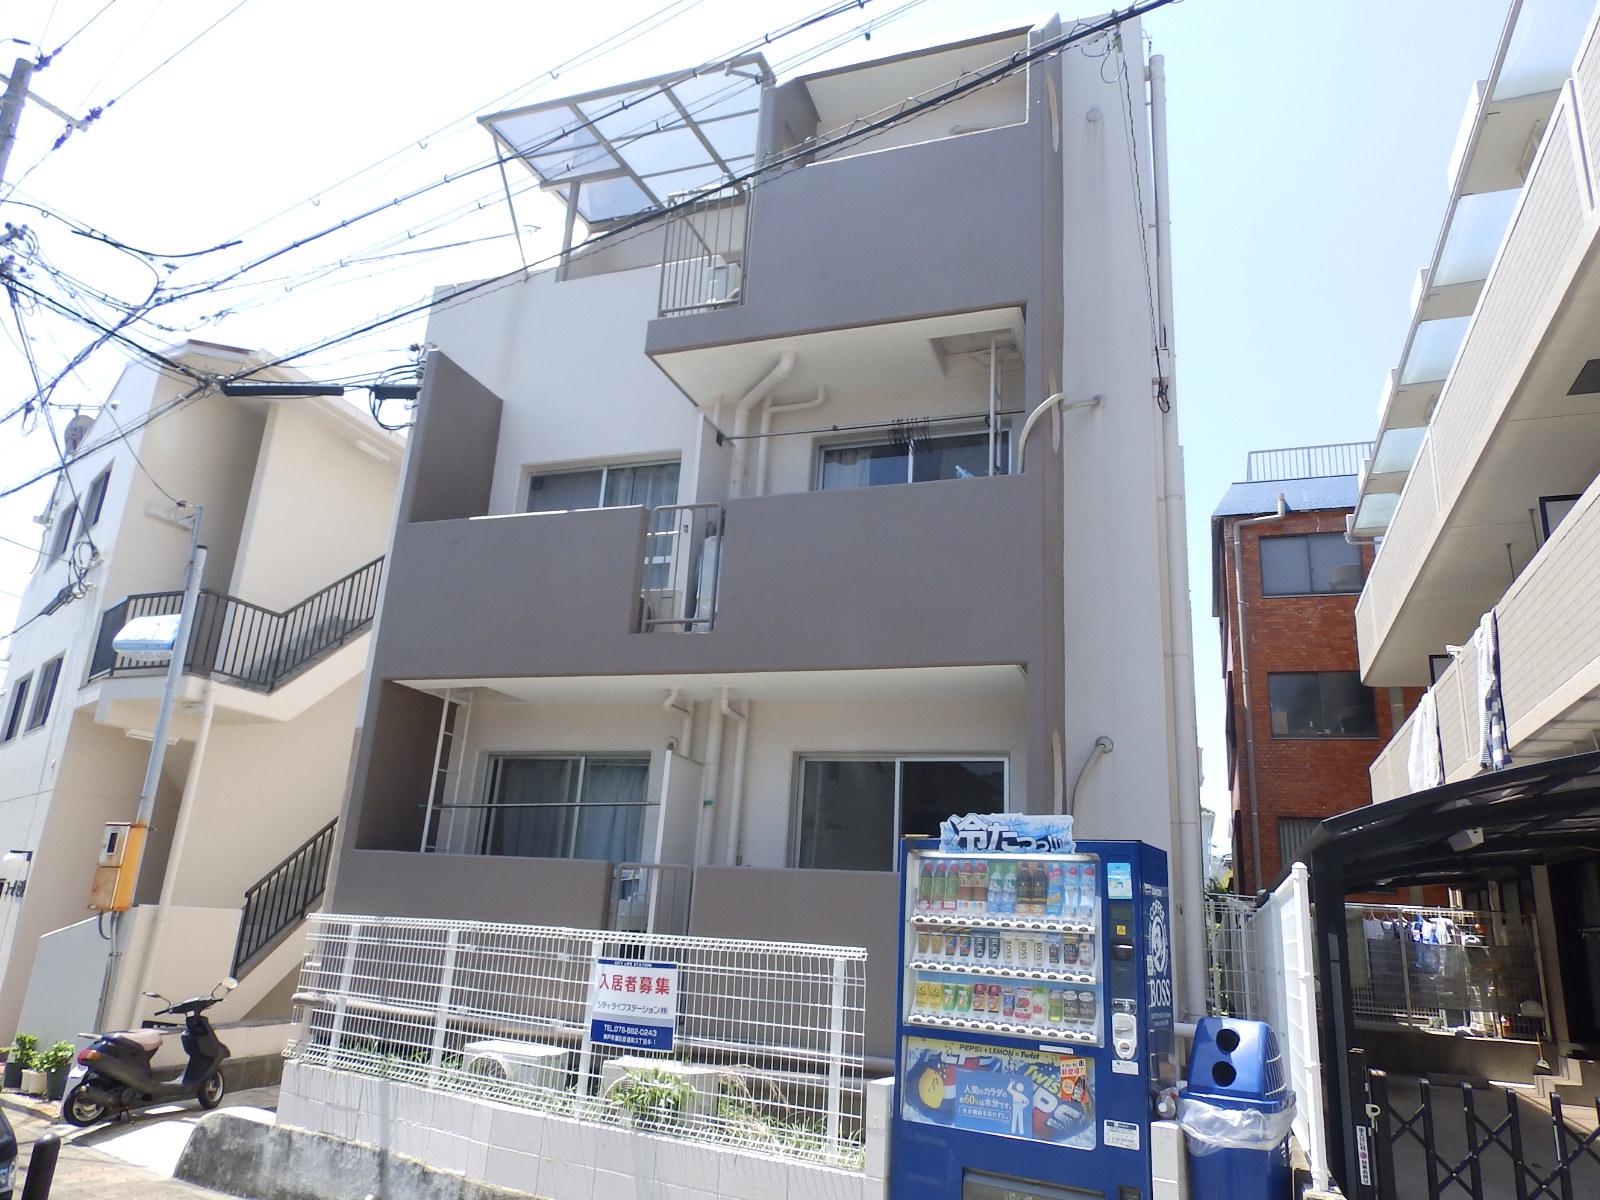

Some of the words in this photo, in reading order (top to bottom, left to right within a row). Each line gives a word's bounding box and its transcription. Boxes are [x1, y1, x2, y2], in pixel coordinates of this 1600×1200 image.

[600, 973, 670, 994] 入居者募集
[1150, 978, 1171, 1007] BOSS
[960, 1044, 983, 1053] PEPSI
[989, 1047, 1014, 1056] LEMON
[1020, 1051, 1040, 1060] Twist
[1024, 1065, 1061, 1094] Twis
